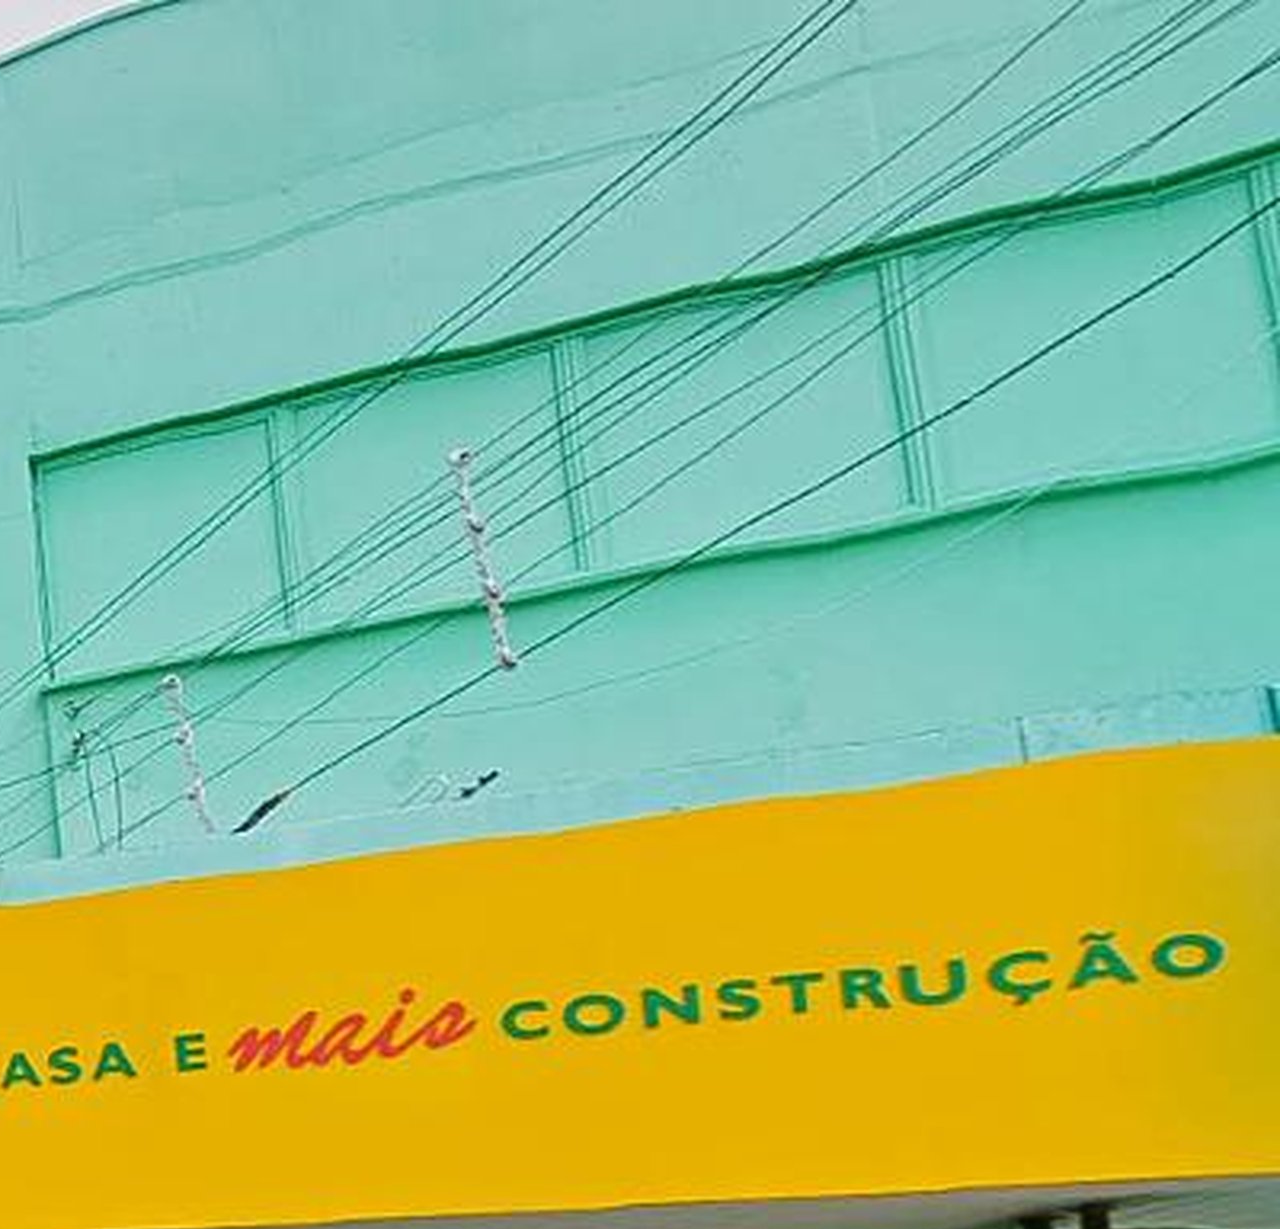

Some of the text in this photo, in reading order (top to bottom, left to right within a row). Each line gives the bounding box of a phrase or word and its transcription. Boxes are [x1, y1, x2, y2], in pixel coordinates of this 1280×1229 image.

[173, 1033, 208, 1072] E
[229, 988, 476, 1072] mais
[500, 931, 1225, 1040] CONSTRUÇÃO
